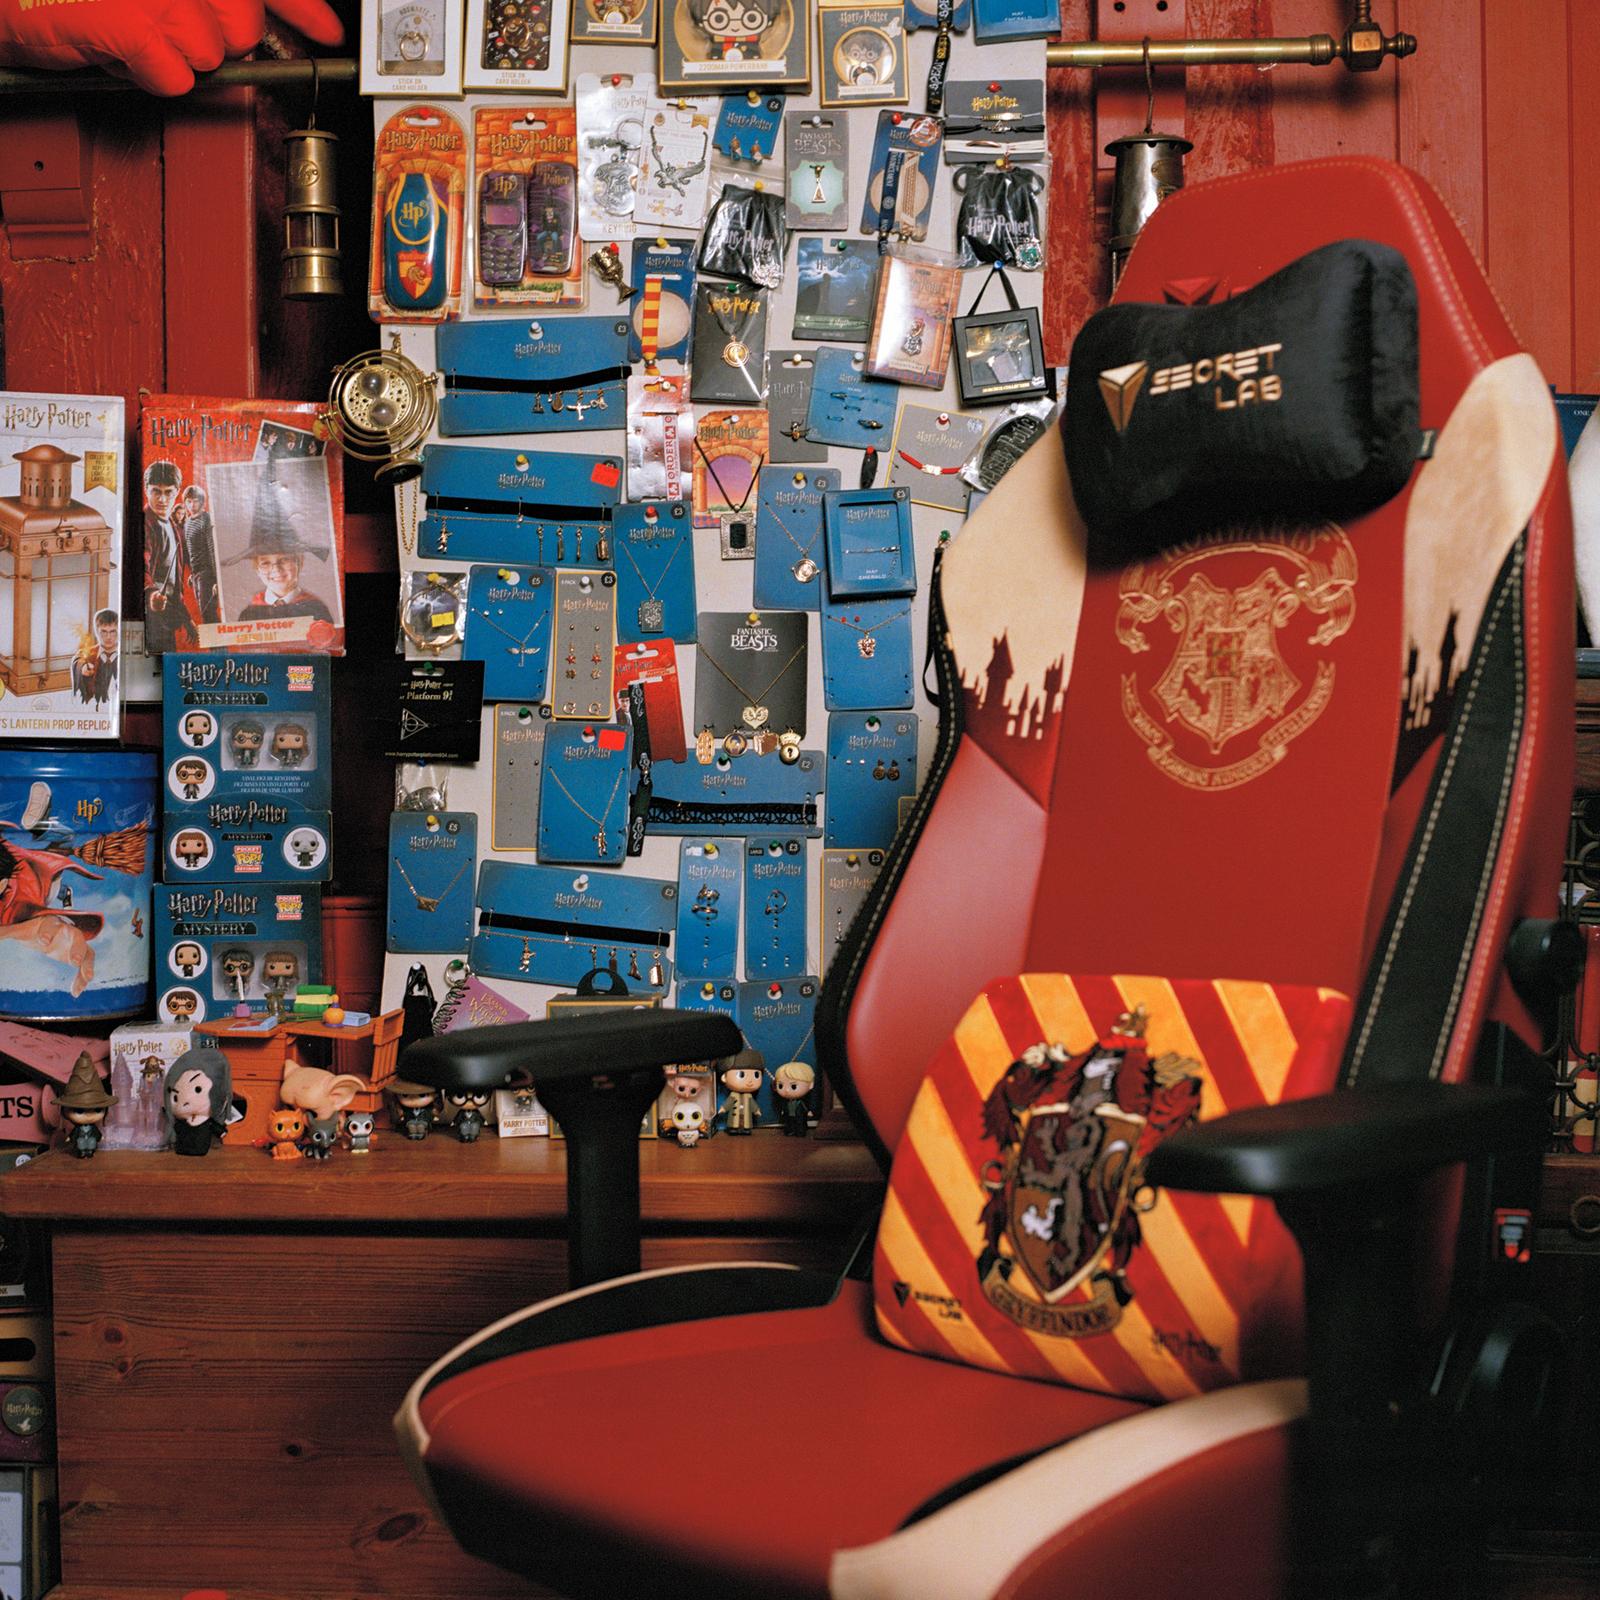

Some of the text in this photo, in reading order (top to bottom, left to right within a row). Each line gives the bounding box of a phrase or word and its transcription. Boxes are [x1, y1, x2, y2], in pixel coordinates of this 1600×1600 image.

[385, 130, 459, 156] Harry Potter
[490, 131, 573, 156] Harry Potter
[794, 138, 841, 155] BEASTS
[1150, 343, 1282, 396] SECRET
[1216, 374, 1282, 410] LAB
[4, 402, 92, 433] Harry Potter
[149, 414, 252, 448] Harry Potter
[665, 440, 676, 480] ORDER
[488, 587, 535, 601] Harry Potter
[217, 620, 295, 634] Harry Potter
[730, 634, 778, 652] BEASTS
[178, 659, 270, 690] Harry Potter
[192, 693, 260, 705] MYSTERY
[406, 691, 441, 700] Platform
[10, 718, 50, 729] LANTERN
[52, 719, 75, 730] PROP
[208, 800, 288, 828] Harry Potter
[168, 889, 258, 920] Harry Potter
[182, 923, 248, 935] MYSTERY
[114, 1039, 162, 1056] Harry Potter
[503, 1119, 547, 1129] HARRY POTTER
